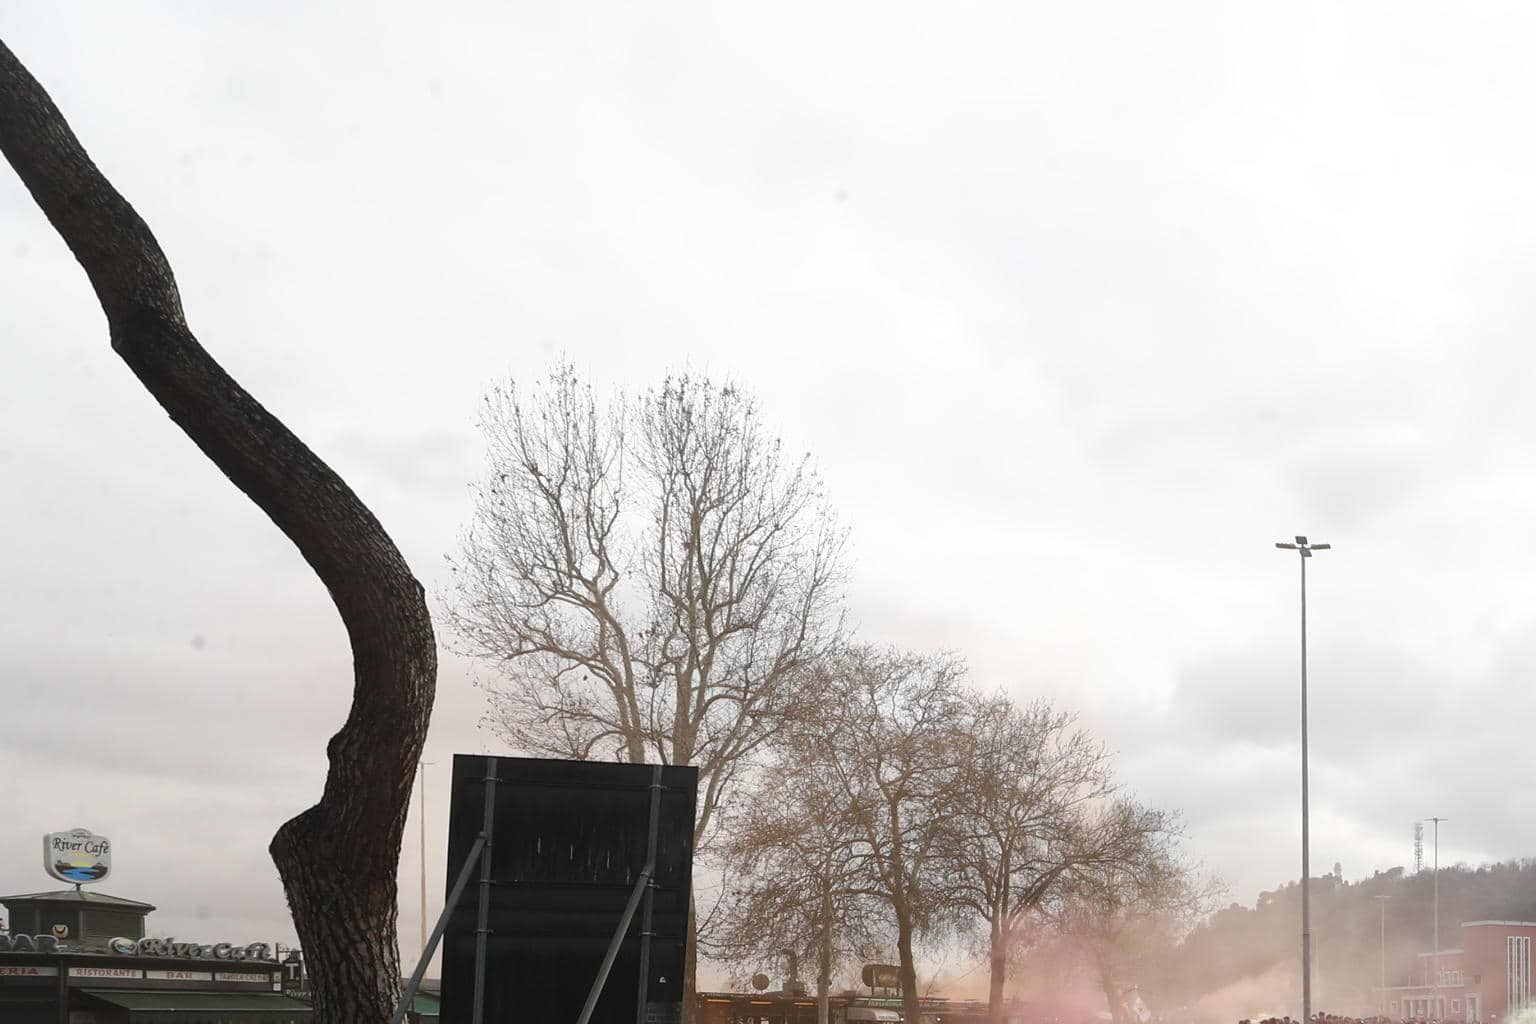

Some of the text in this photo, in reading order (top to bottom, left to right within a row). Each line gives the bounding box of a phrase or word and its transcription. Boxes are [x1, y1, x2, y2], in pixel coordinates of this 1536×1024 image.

[52, 837, 82, 852] River
[142, 937, 213, 960] River
[75, 968, 137, 977] RISTORANTE
[166, 971, 193, 979] BAR
